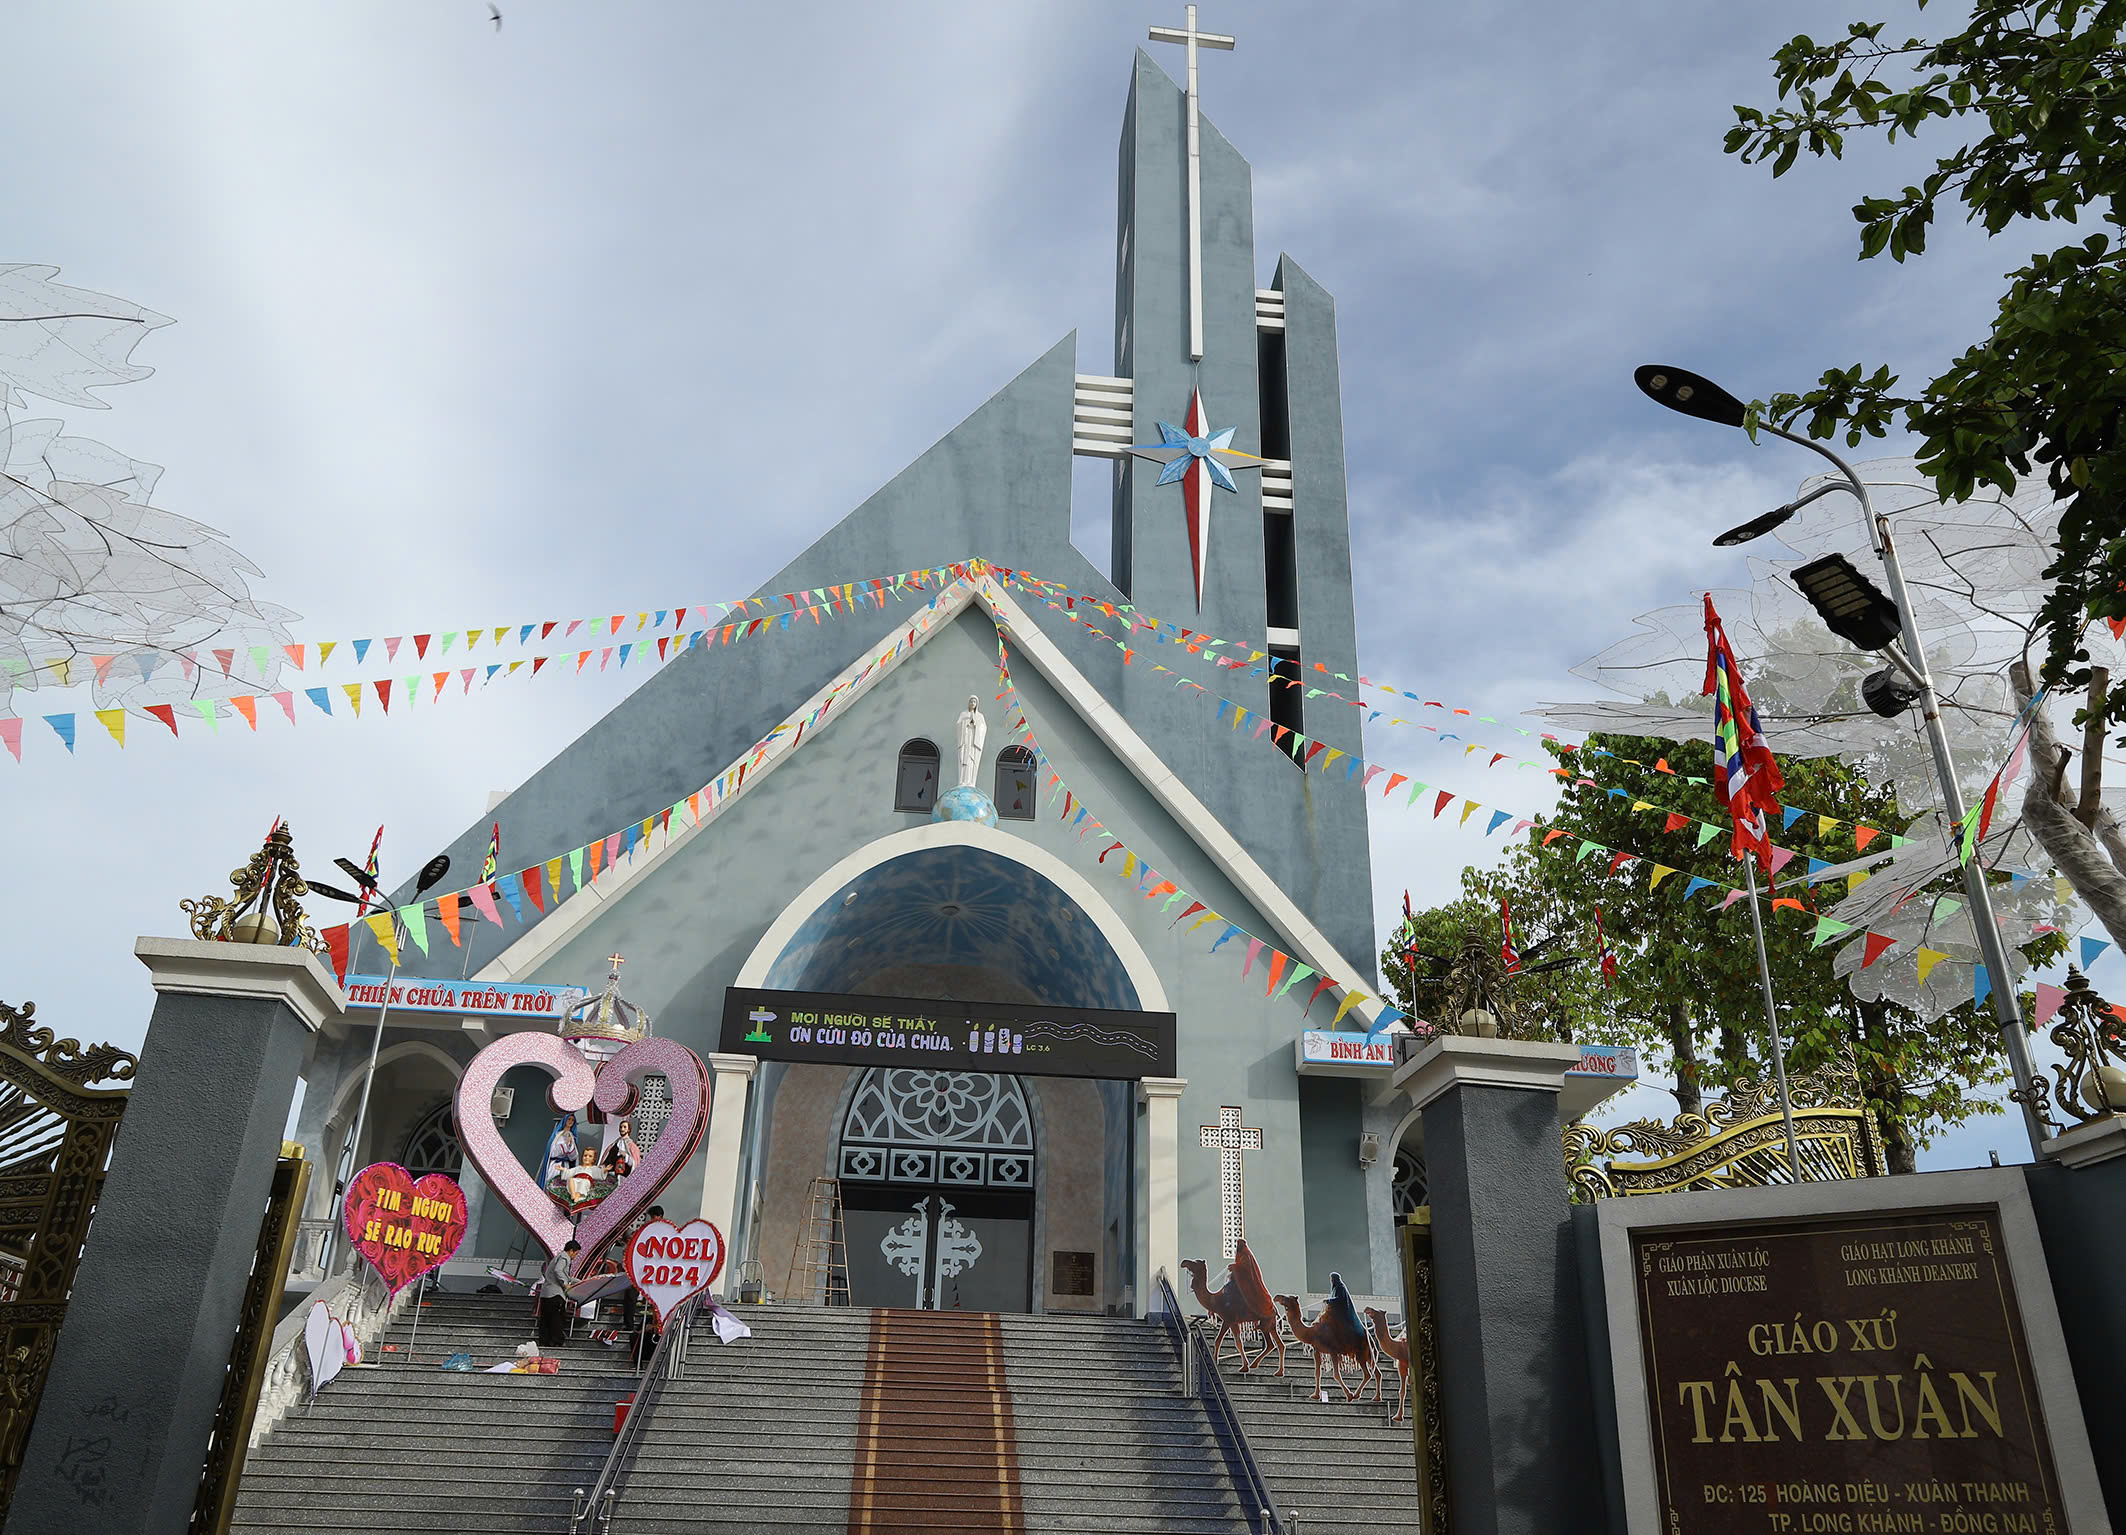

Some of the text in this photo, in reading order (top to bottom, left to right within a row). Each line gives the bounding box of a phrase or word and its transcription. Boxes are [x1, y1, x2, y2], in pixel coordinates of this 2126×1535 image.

[407, 984, 456, 1007] CHÚA
[461, 987, 508, 1009] TRÊN
[512, 989, 555, 1012] TRỜI
[790, 1026, 811, 1043] ƠN
[816, 1025, 846, 1045] CỨU
[877, 1028, 906, 1049] CỦA
[911, 1031, 953, 1051] CHÚA.
[1330, 1037, 1362, 1059] BÌNH
[1366, 1043, 1385, 1060] AN
[376, 1188, 401, 1211] TIM
[384, 1225, 413, 1251] RẠO
[645, 1236, 714, 1260] NOEL
[1841, 1233, 1975, 1262] GIÁO HẠT LONG KHÁNH
[1659, 1247, 1770, 1274] GIÁO PHẬN XUÂN LỘC
[641, 1265, 699, 1286] 2024
[1667, 1274, 1768, 1298] XUÂN LỘC DIOCESE
[1845, 1262, 1979, 1286] LONG KHÁNH DEANERY
[1748, 1307, 1898, 1355] GIÁO XỨ
[1678, 1353, 2004, 1443] TÂN XUÂN
[1704, 1484, 1734, 1503] ĐC:
[1739, 1485, 1767, 1503] 125
[1776, 1479, 1841, 1503] HOÀNG
[1845, 1478, 1889, 1506] DIỆU
[1904, 1478, 1958, 1503] XUÂN
[1961, 1482, 2030, 1503] THANH
[1768, 1513, 1798, 1533] TP.
[1801, 1513, 1852, 1533] LONG
[1857, 1508, 1924, 1533] KHÁNH
[1940, 1505, 1998, 1533] ĐỒNG
[2002, 1513, 2038, 1534] NAI
